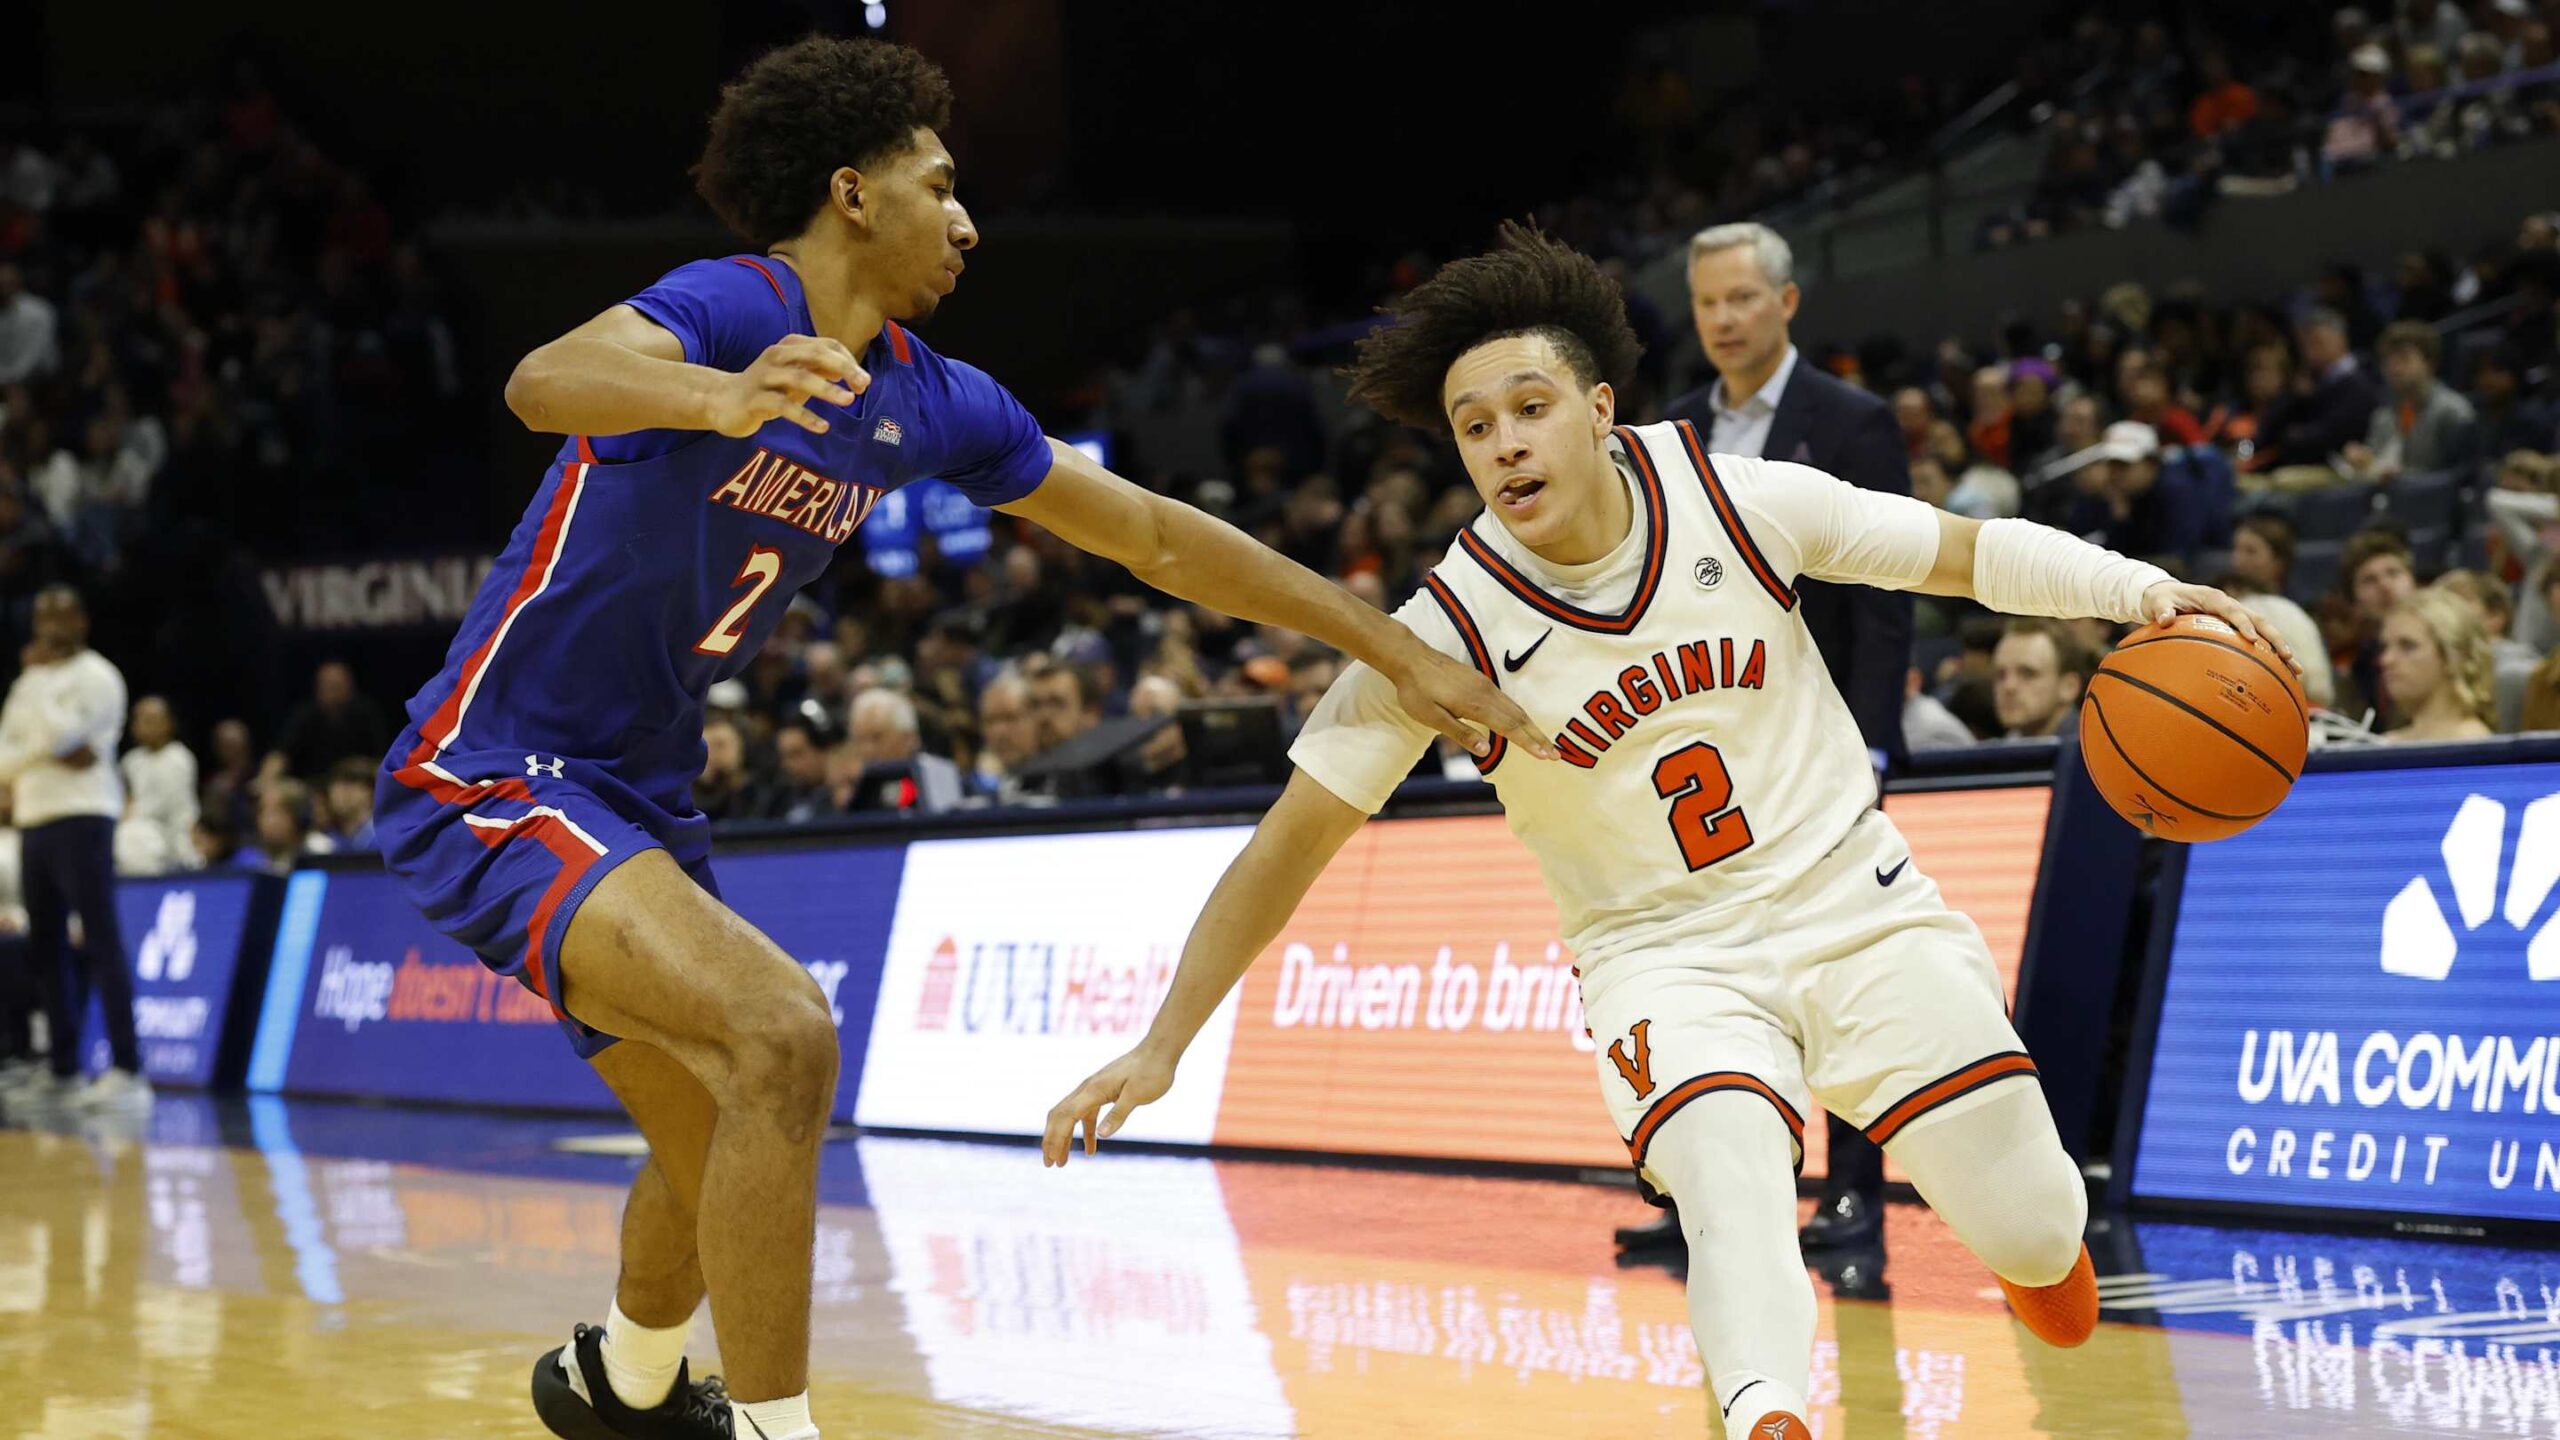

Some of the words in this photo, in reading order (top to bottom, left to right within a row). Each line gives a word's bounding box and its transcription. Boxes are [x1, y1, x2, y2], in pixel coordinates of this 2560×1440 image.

[708, 447, 885, 545] AMERICAN
[692, 543, 783, 656] 2
[1554, 637, 1766, 769] VIRGINIA
[1651, 740, 1755, 873] 2
[314, 943, 394, 1033] Hope
[962, 941, 1054, 1034] UVA
[1056, 941, 1184, 1035] Healt
[1273, 941, 1421, 1030] Driven
[1426, 945, 1479, 1031] to
[1607, 1018, 1656, 1101] V
[2237, 1029, 2341, 1107] UVA
[2226, 1126, 2449, 1186] CREDIT
